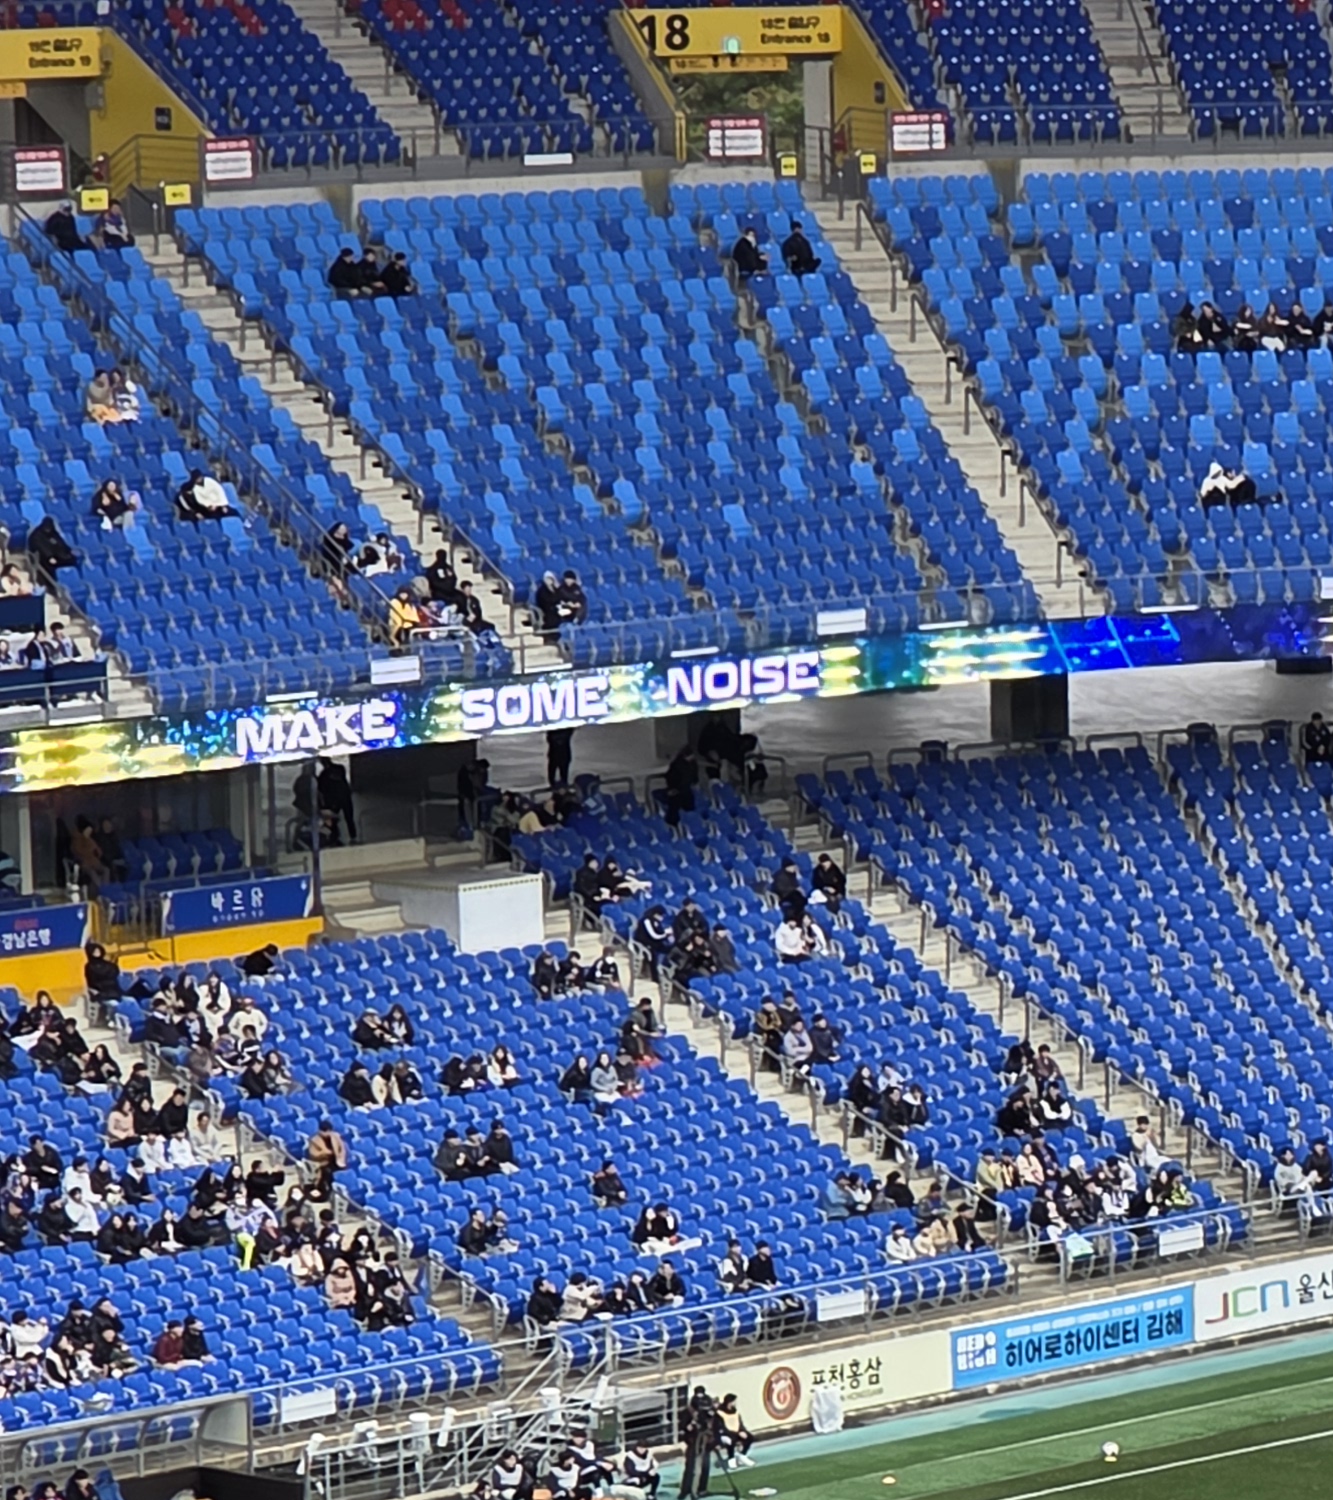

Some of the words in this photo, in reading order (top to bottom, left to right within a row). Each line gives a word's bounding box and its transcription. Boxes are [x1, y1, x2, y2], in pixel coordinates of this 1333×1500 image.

[637, 15, 690, 51] 18
[760, 33, 812, 44] Entrance
[236, 701, 396, 755] MAKE
[462, 675, 609, 731] SOME
[667, 651, 820, 705] NOISE
[1004, 1317, 1140, 1368] 히어로하이센터
[1146, 1308, 1183, 1341] 김해
